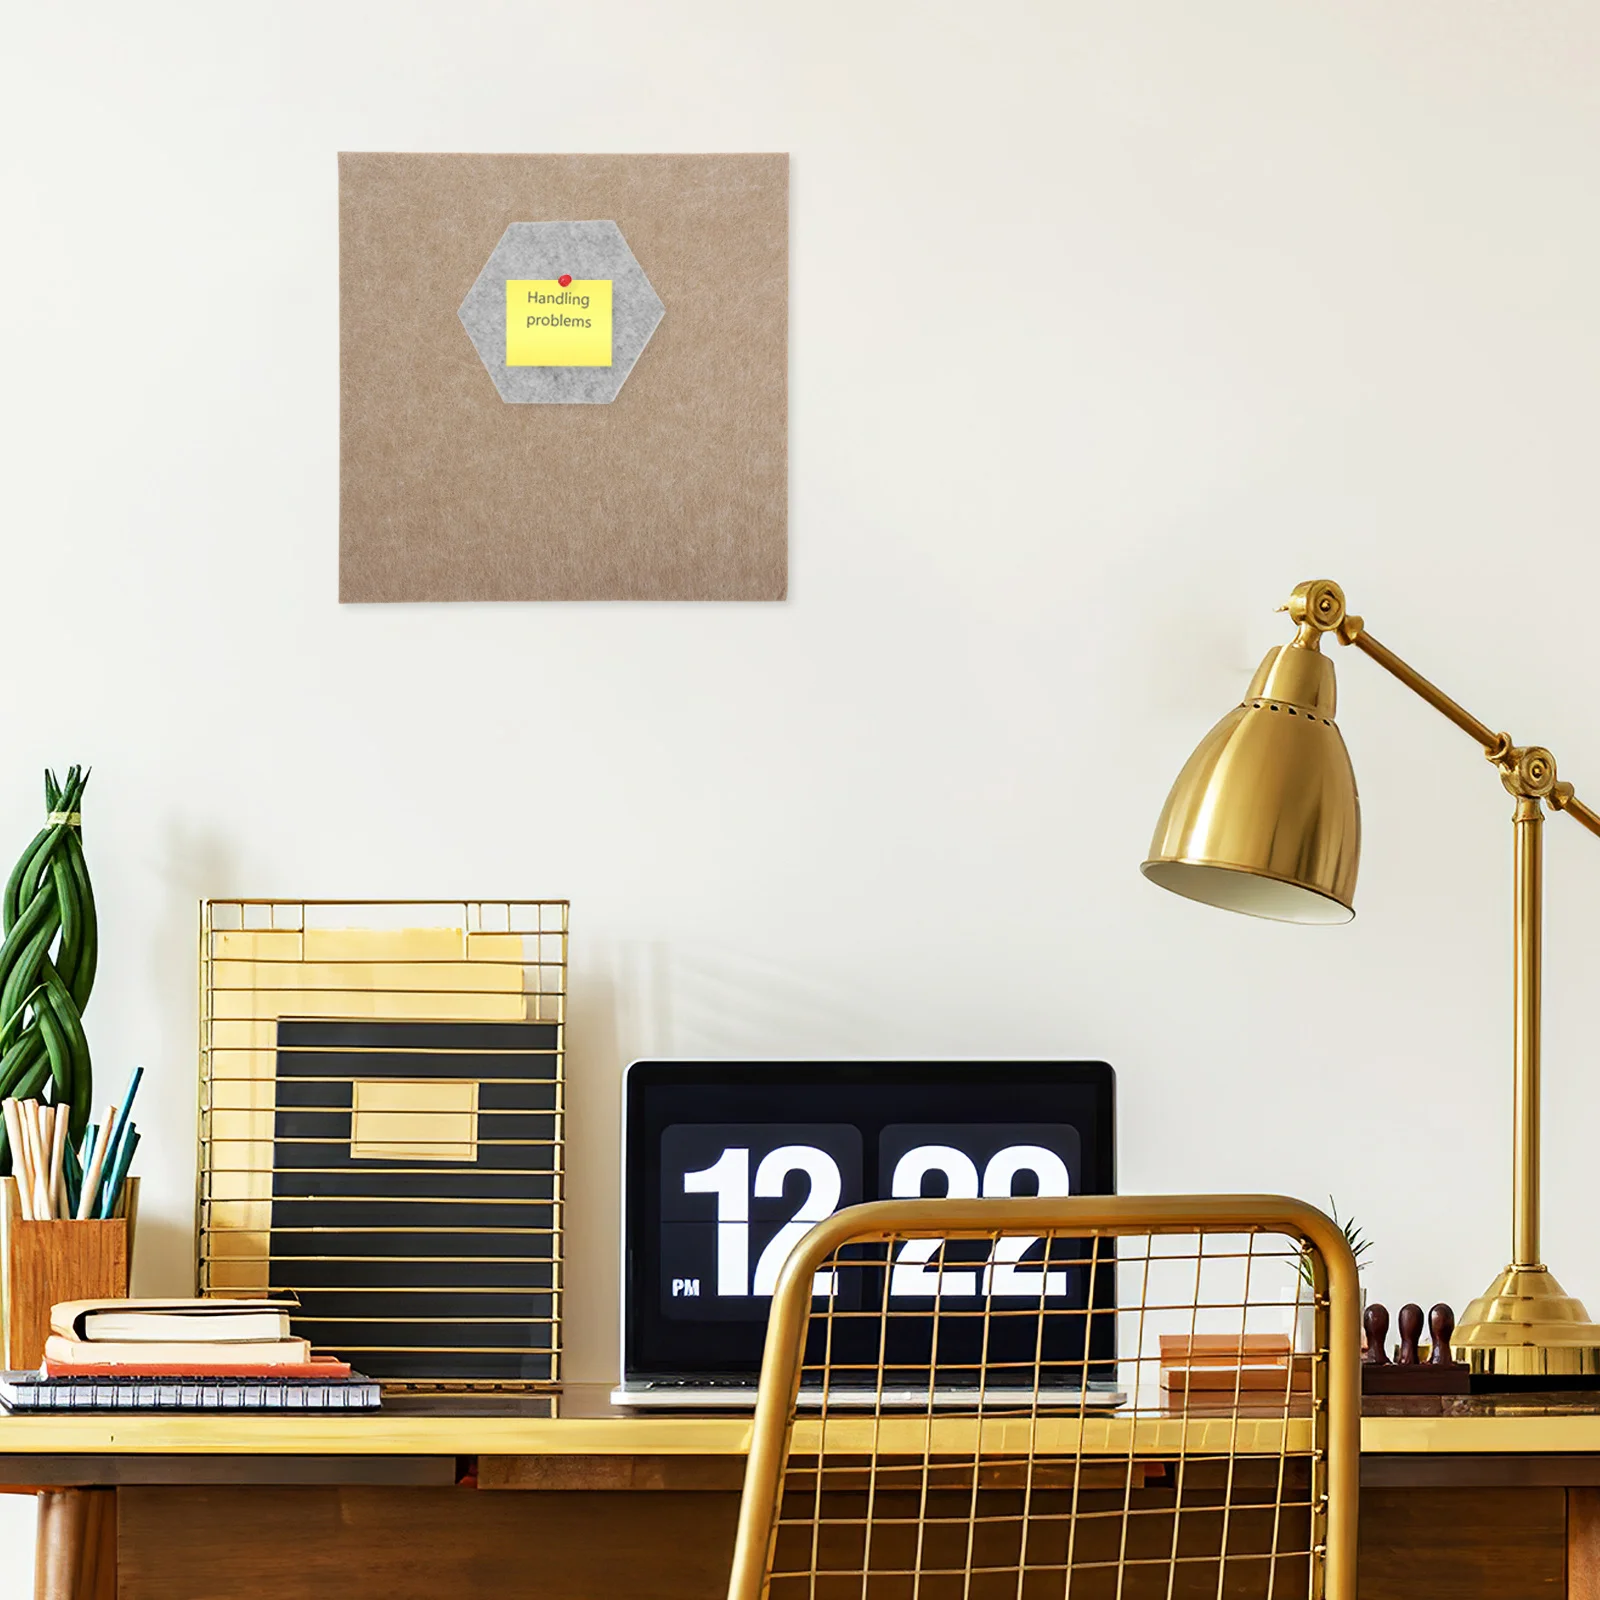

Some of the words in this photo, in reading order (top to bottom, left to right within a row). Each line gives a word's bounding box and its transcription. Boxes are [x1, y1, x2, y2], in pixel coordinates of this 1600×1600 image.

[527, 291, 590, 309] Handling
[526, 314, 592, 329] problems
[684, 1145, 842, 1298] 12
[891, 1145, 1070, 1297] 22
[672, 1278, 700, 1297] PM
